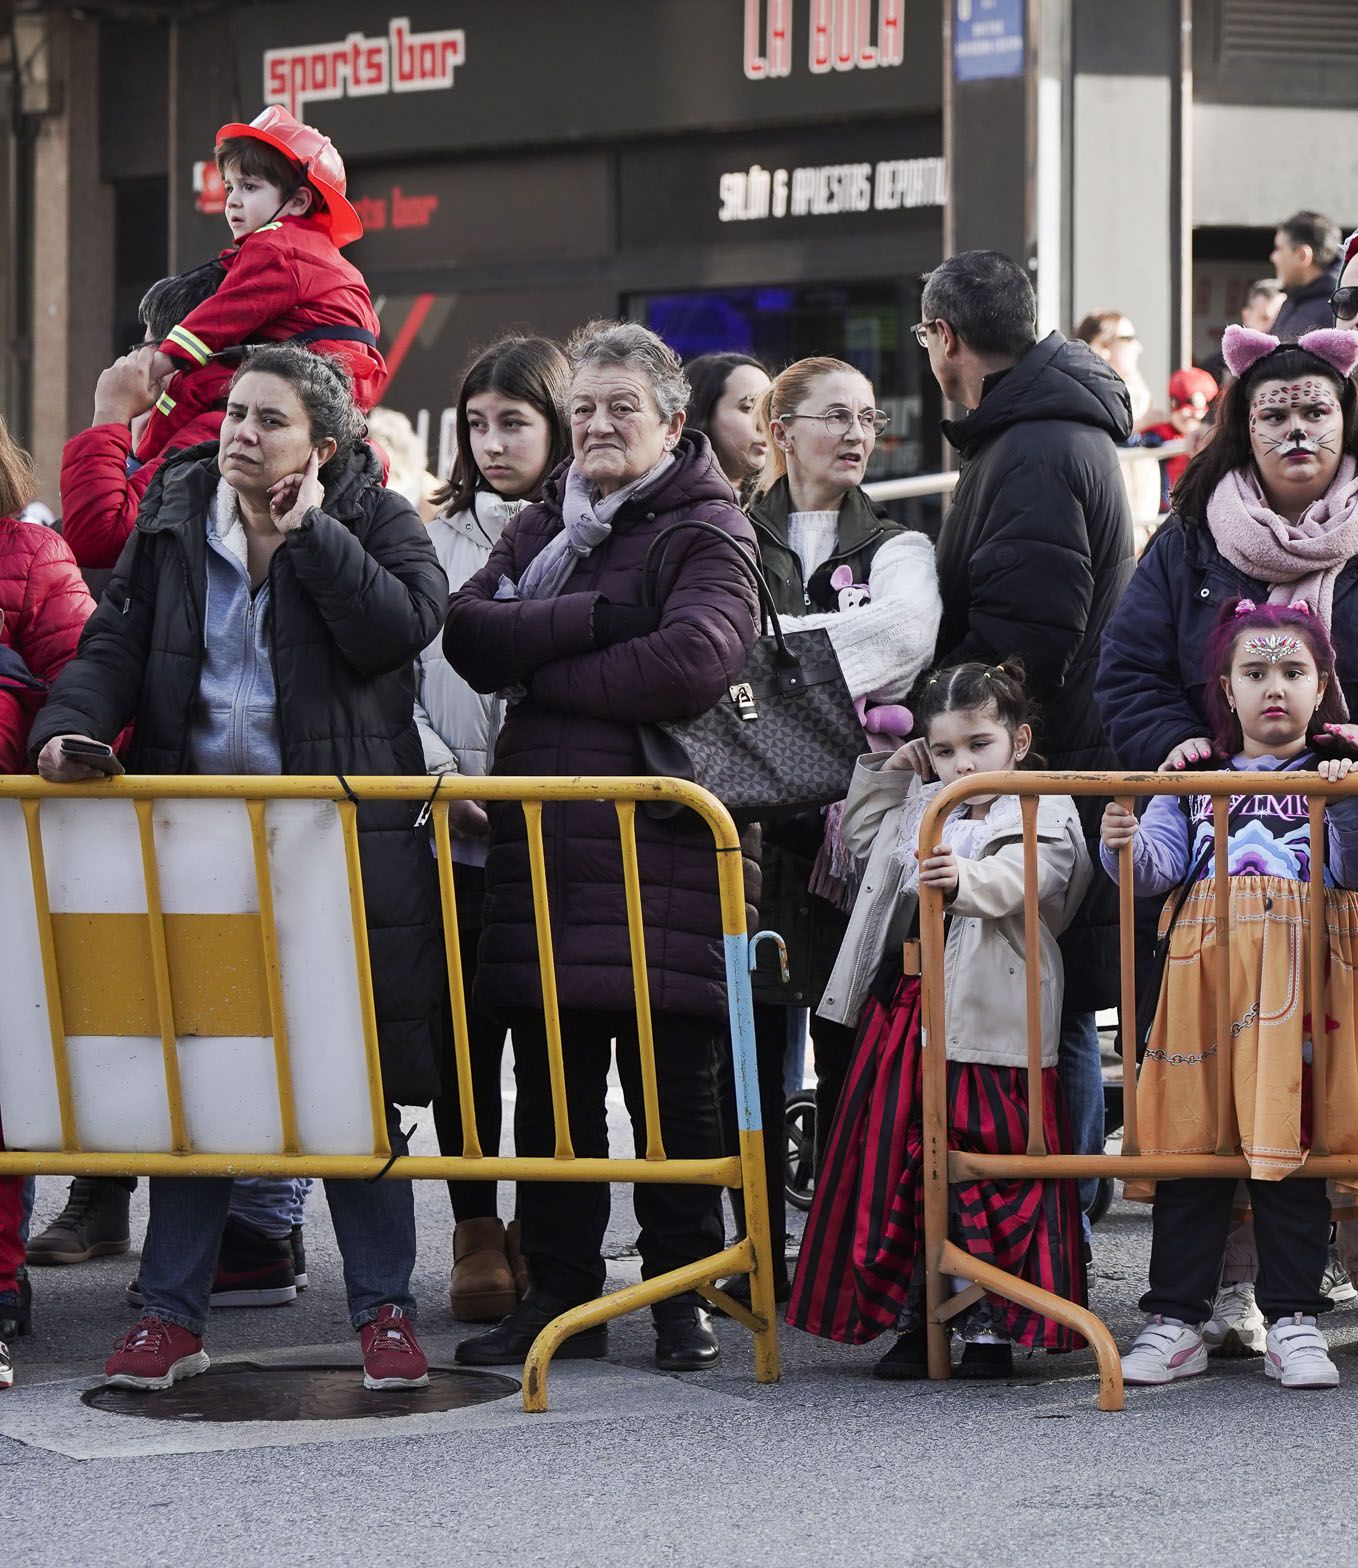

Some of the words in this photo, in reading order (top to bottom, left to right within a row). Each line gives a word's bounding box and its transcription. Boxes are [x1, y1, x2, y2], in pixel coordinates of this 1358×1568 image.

[267, 38, 386, 121] sports
[392, 22, 461, 88] bar
[744, 0, 792, 79] LA
[791, 163, 871, 216] APUESTAS
